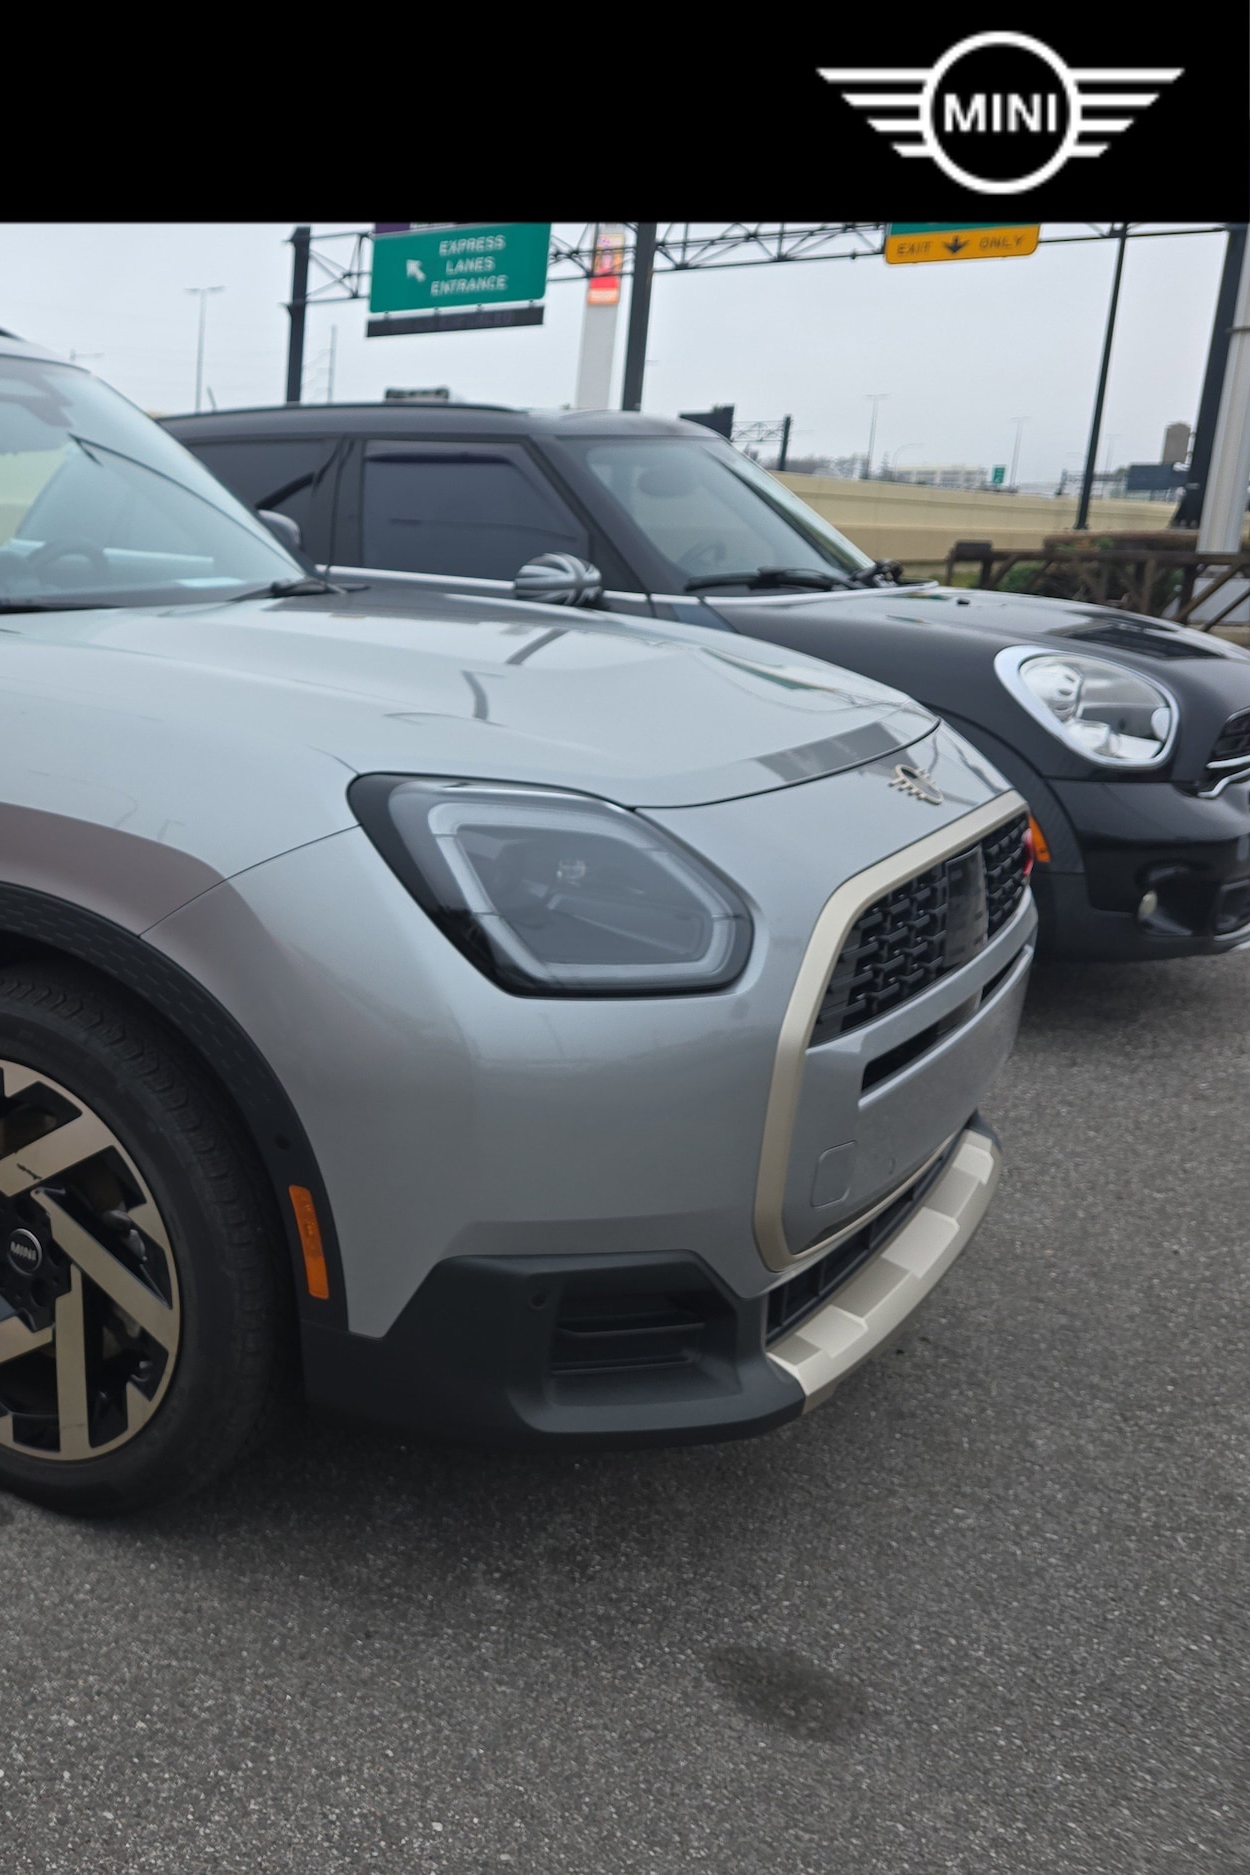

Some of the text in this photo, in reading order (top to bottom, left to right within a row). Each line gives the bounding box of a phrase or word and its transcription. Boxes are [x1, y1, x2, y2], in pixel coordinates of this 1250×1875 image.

[439, 234, 506, 256] EXPRESS
[897, 234, 1024, 255] EXIT ONLY
[446, 256, 495, 275] LANES
[431, 275, 508, 296] ENTRANCE
[11, 1242, 36, 1260] MINI
